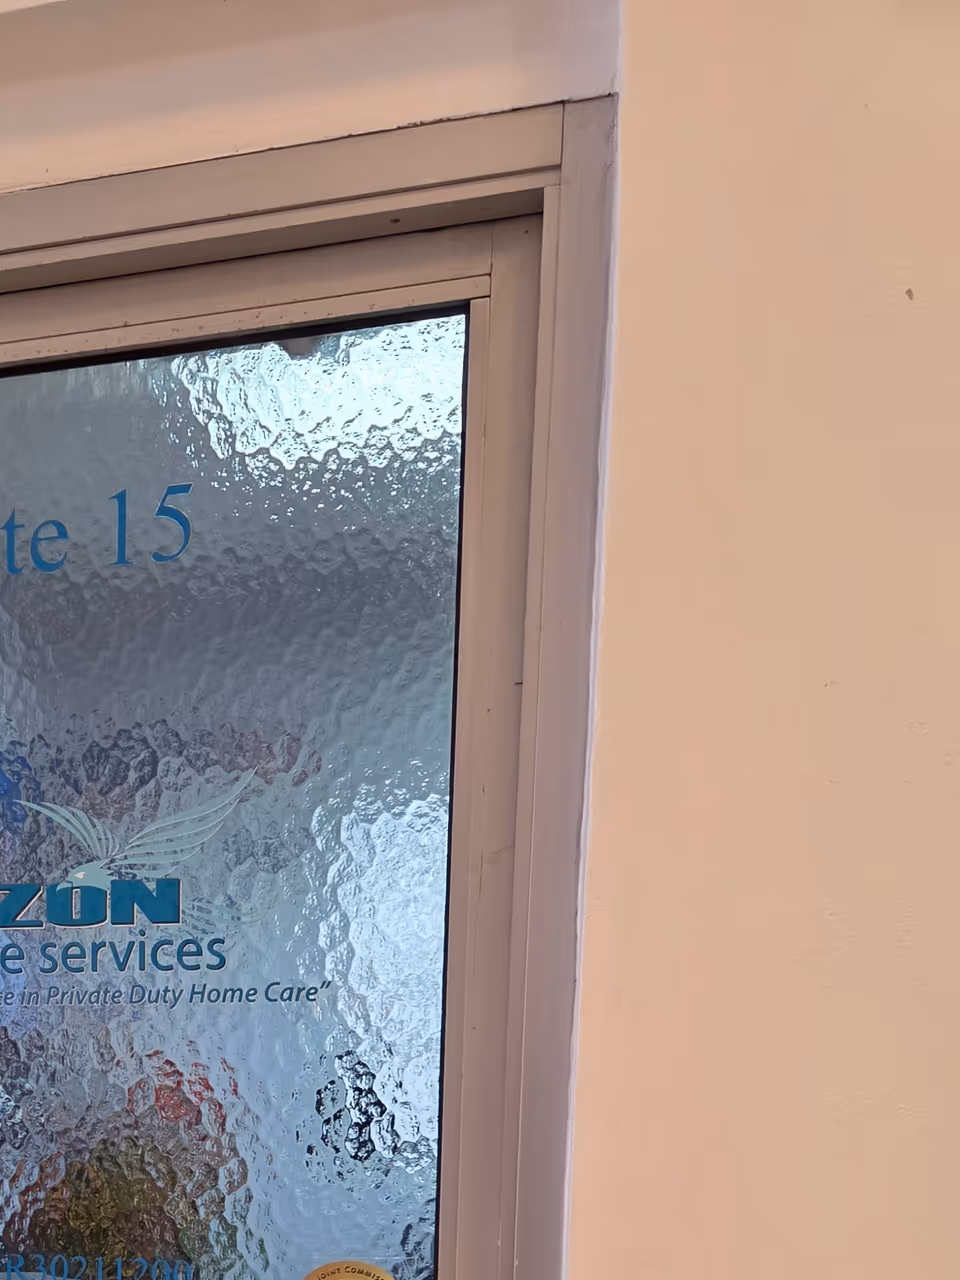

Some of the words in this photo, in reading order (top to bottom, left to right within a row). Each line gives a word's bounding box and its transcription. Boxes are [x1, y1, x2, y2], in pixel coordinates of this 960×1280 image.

[109, 482, 194, 566] 15
[38, 929, 226, 974] services
[21, 988, 40, 1005] in
[45, 986, 123, 1006] Private
[129, 985, 184, 1009] Duty
[189, 984, 258, 1004] Home
